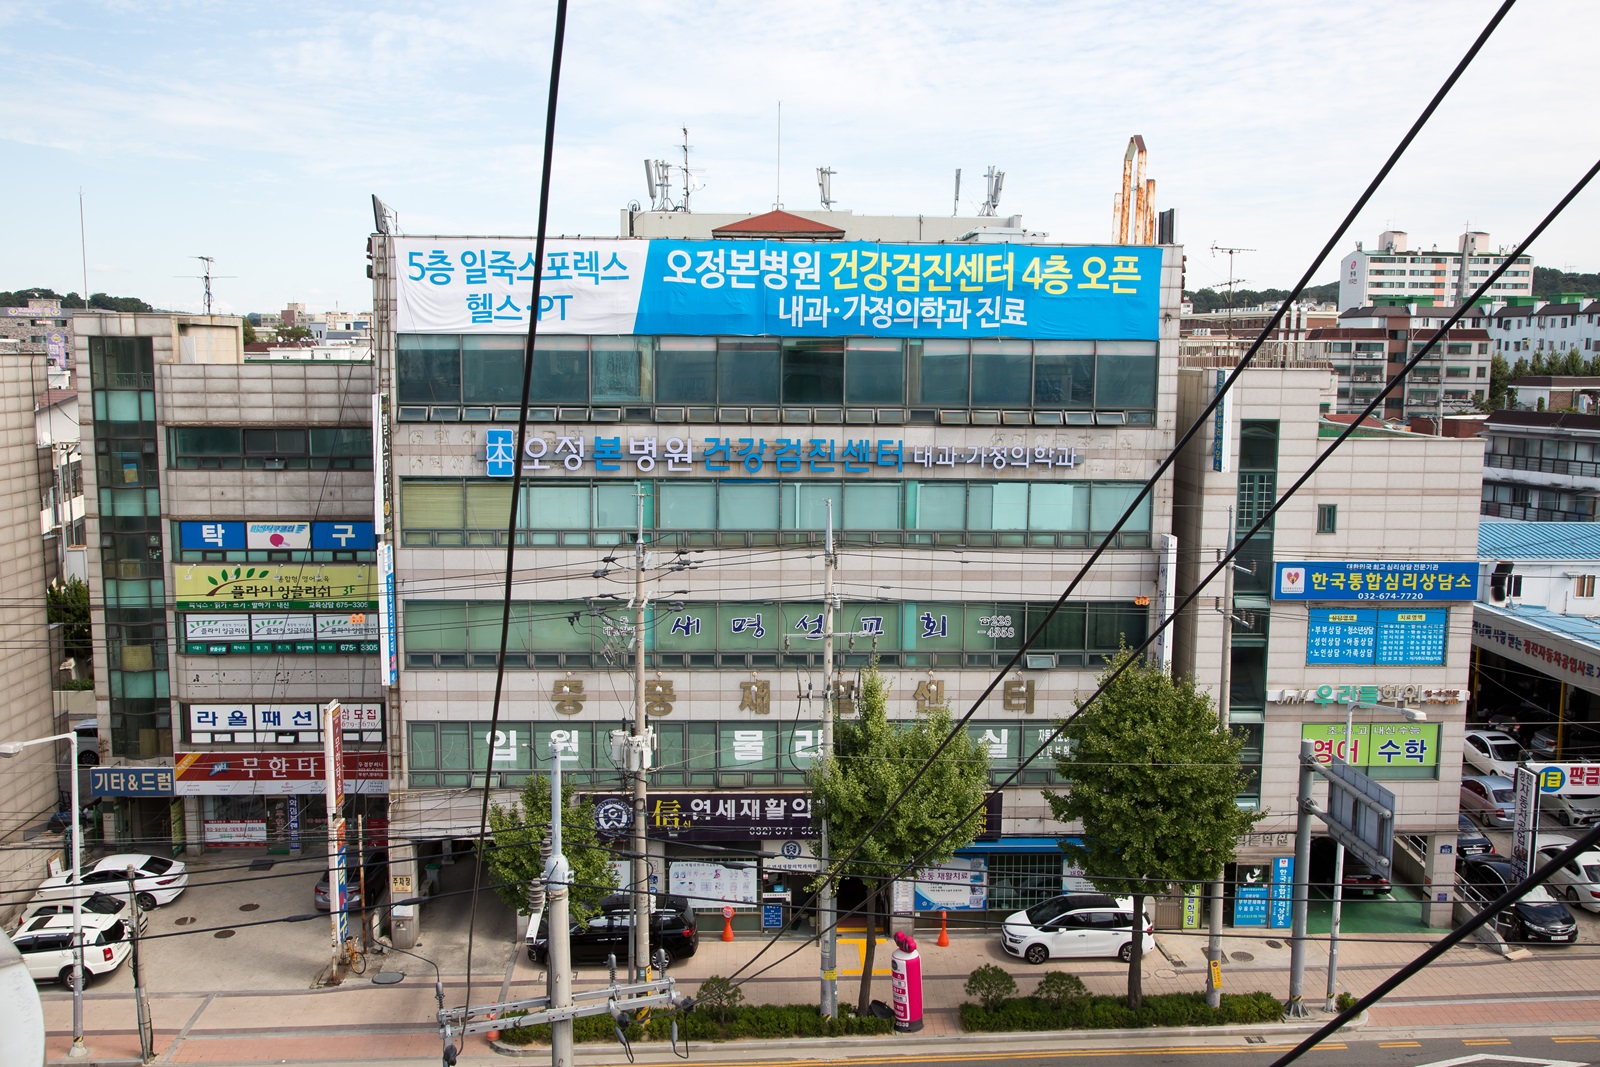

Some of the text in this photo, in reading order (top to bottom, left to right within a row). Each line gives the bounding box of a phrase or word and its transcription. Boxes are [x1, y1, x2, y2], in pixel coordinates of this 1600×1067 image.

[408, 250, 630, 286] 5층 일죽스포렉스
[663, 249, 1142, 294] 오정본병원 건강검진센터 4층 오픈
[779, 295, 1028, 330] 내과·가정의학과 진료
[522, 435, 693, 473] 오정본병원
[703, 438, 904, 473] 건강검진센터
[913, 445, 1077, 470] 내과·가정의학과
[202, 523, 225, 547] 탁
[331, 524, 356, 547] 구
[231, 585, 274, 599] 플라이
[278, 585, 331, 600] 잉글리쉬
[1311, 572, 1472, 591] 한국통합심리상담소
[1358, 592, 1424, 600] 032-674-7720
[1373, 726, 1396, 735] 내신
[1398, 726, 1421, 735] 수능
[1314, 739, 1428, 763] 영어 수학
[241, 756, 345, 779] 무한타
[1540, 766, 1600, 788] 1급 판금
[94, 772, 172, 792] 기타&드럼
[690, 799, 823, 821] 연세재활의
[937, 872, 969, 880] 재활치료
